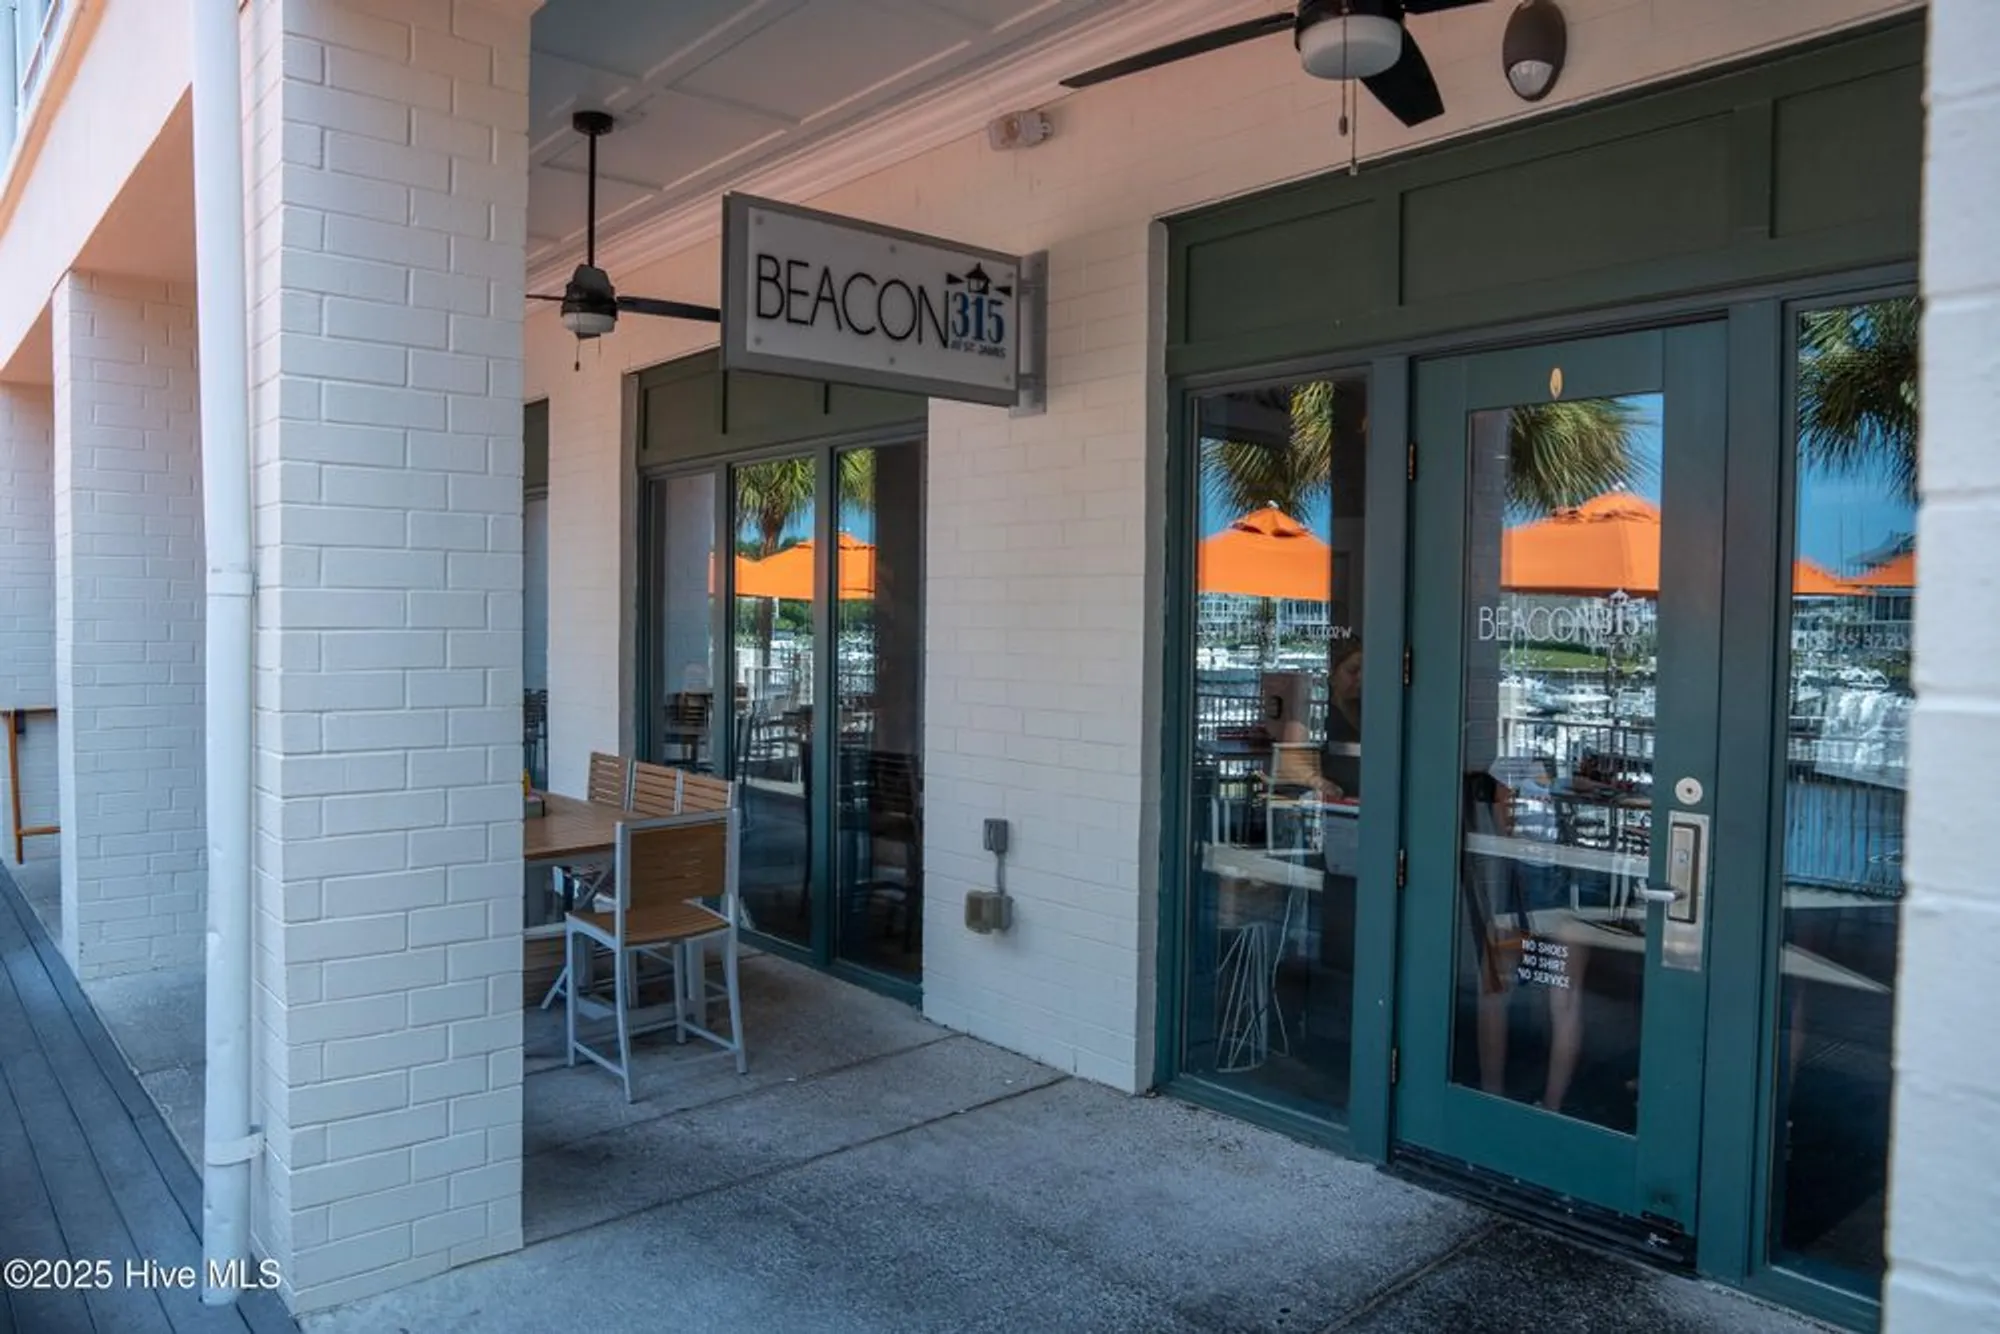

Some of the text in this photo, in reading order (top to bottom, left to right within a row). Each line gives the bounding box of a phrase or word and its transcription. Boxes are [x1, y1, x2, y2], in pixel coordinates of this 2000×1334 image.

[756, 253, 1005, 349] BEACON 315
[1478, 606, 1597, 642] BEACON
[1521, 939, 1569, 958] NO SHOES
[1523, 954, 1567, 973] NO SHIRT
[1518, 966, 1570, 988] NO SERVICE
